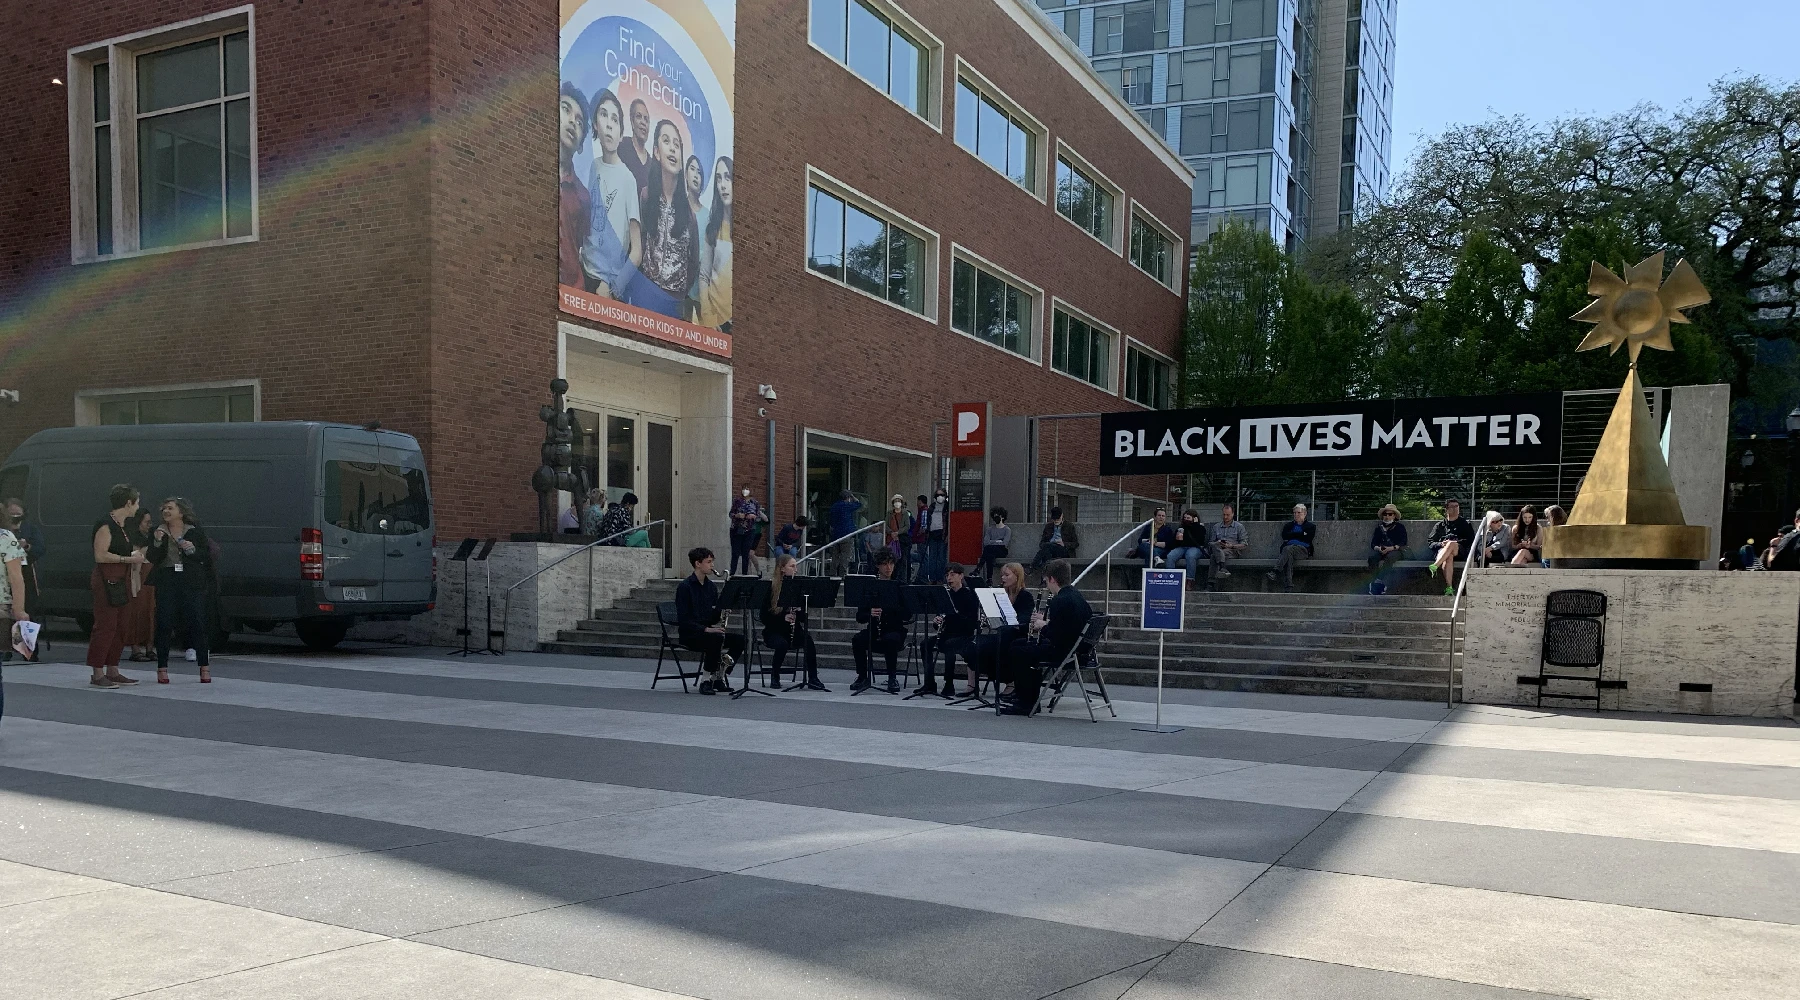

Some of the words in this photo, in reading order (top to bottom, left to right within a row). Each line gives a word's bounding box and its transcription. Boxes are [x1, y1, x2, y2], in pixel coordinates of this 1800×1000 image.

[619, 26, 655, 68] Find
[657, 58, 682, 83] your
[604, 49, 702, 122] Connection
[564, 293, 586, 310] FREE
[588, 302, 636, 324] ADMISSION
[638, 315, 655, 329] FOR
[656, 320, 674, 335] KIDS
[675, 327, 683, 337] 17
[685, 329, 701, 342] AND
[703, 335, 728, 350] UNDER
[958, 411, 980, 441] P
[1114, 425, 1230, 457] BLACK
[1249, 420, 1352, 453] LIVES
[1371, 413, 1542, 450] MATTER
